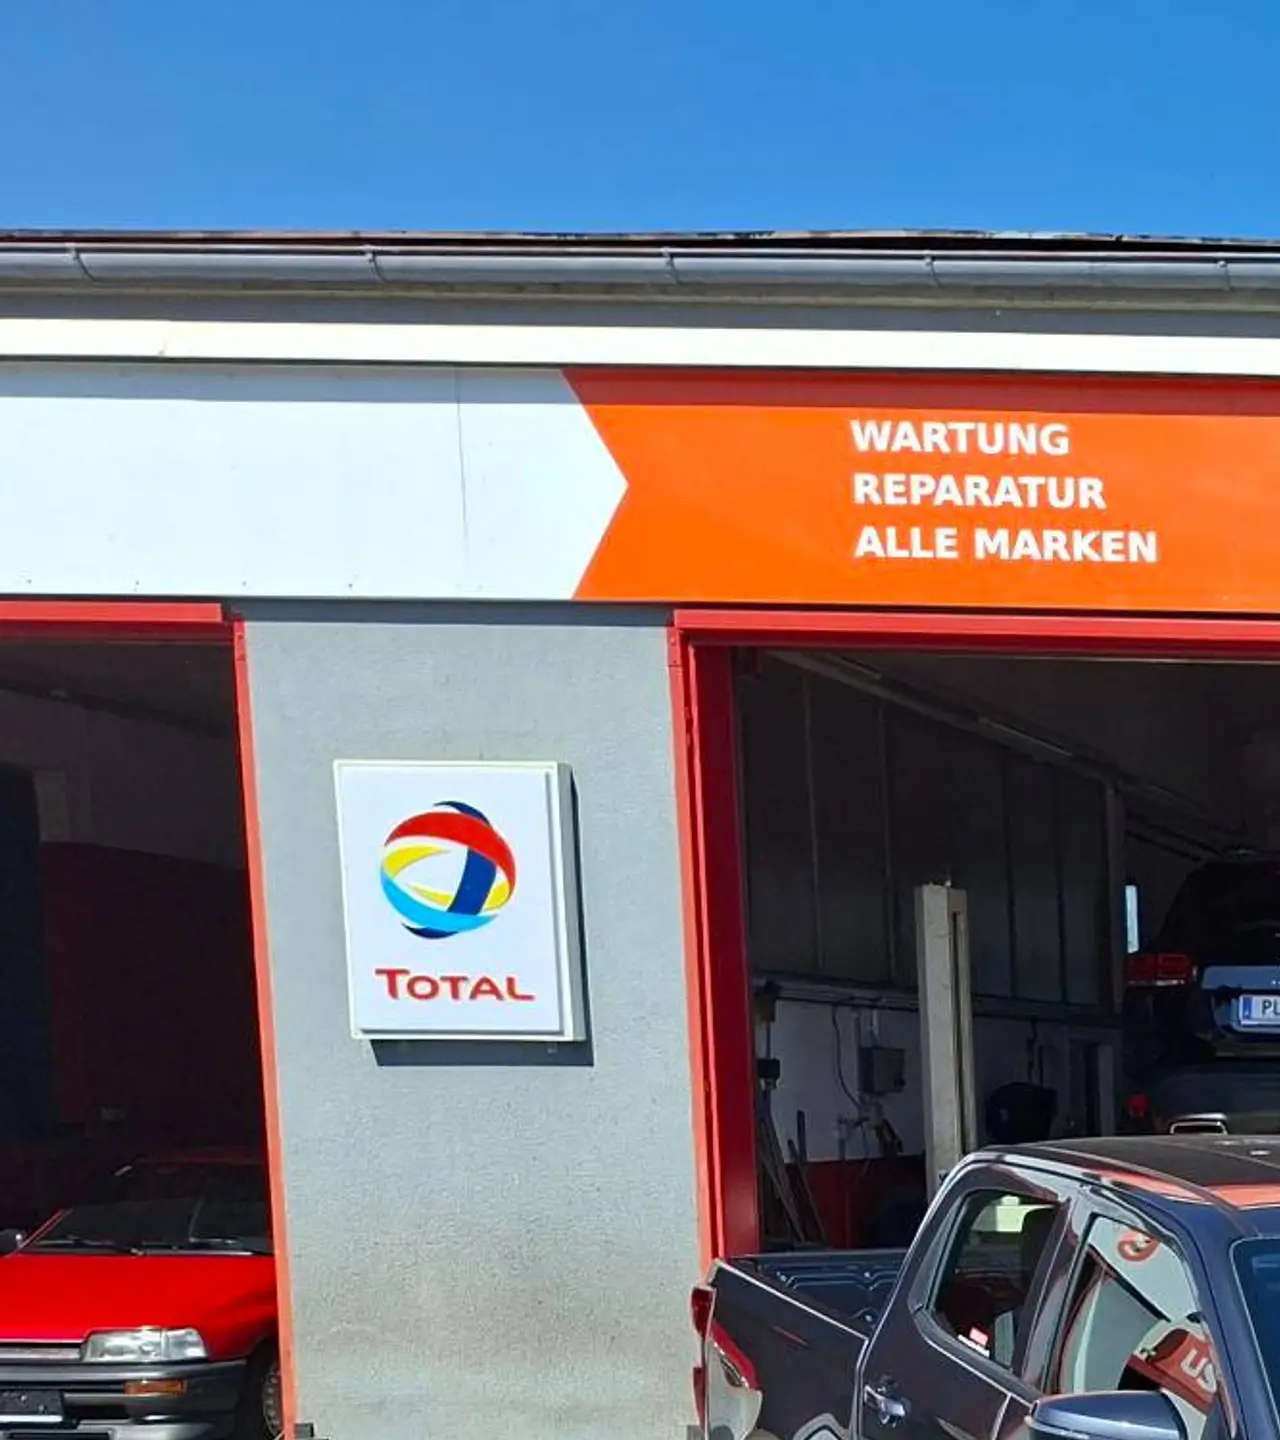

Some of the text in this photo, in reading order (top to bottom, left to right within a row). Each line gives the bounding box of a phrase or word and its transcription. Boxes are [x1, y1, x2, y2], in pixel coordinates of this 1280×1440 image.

[850, 419, 1070, 456] WARTUNG
[853, 473, 1107, 510] REPARATUR
[855, 525, 1158, 563] ALLE MARKEN
[375, 968, 536, 1001] TOTAL
[1262, 1000, 1280, 1016] PL
